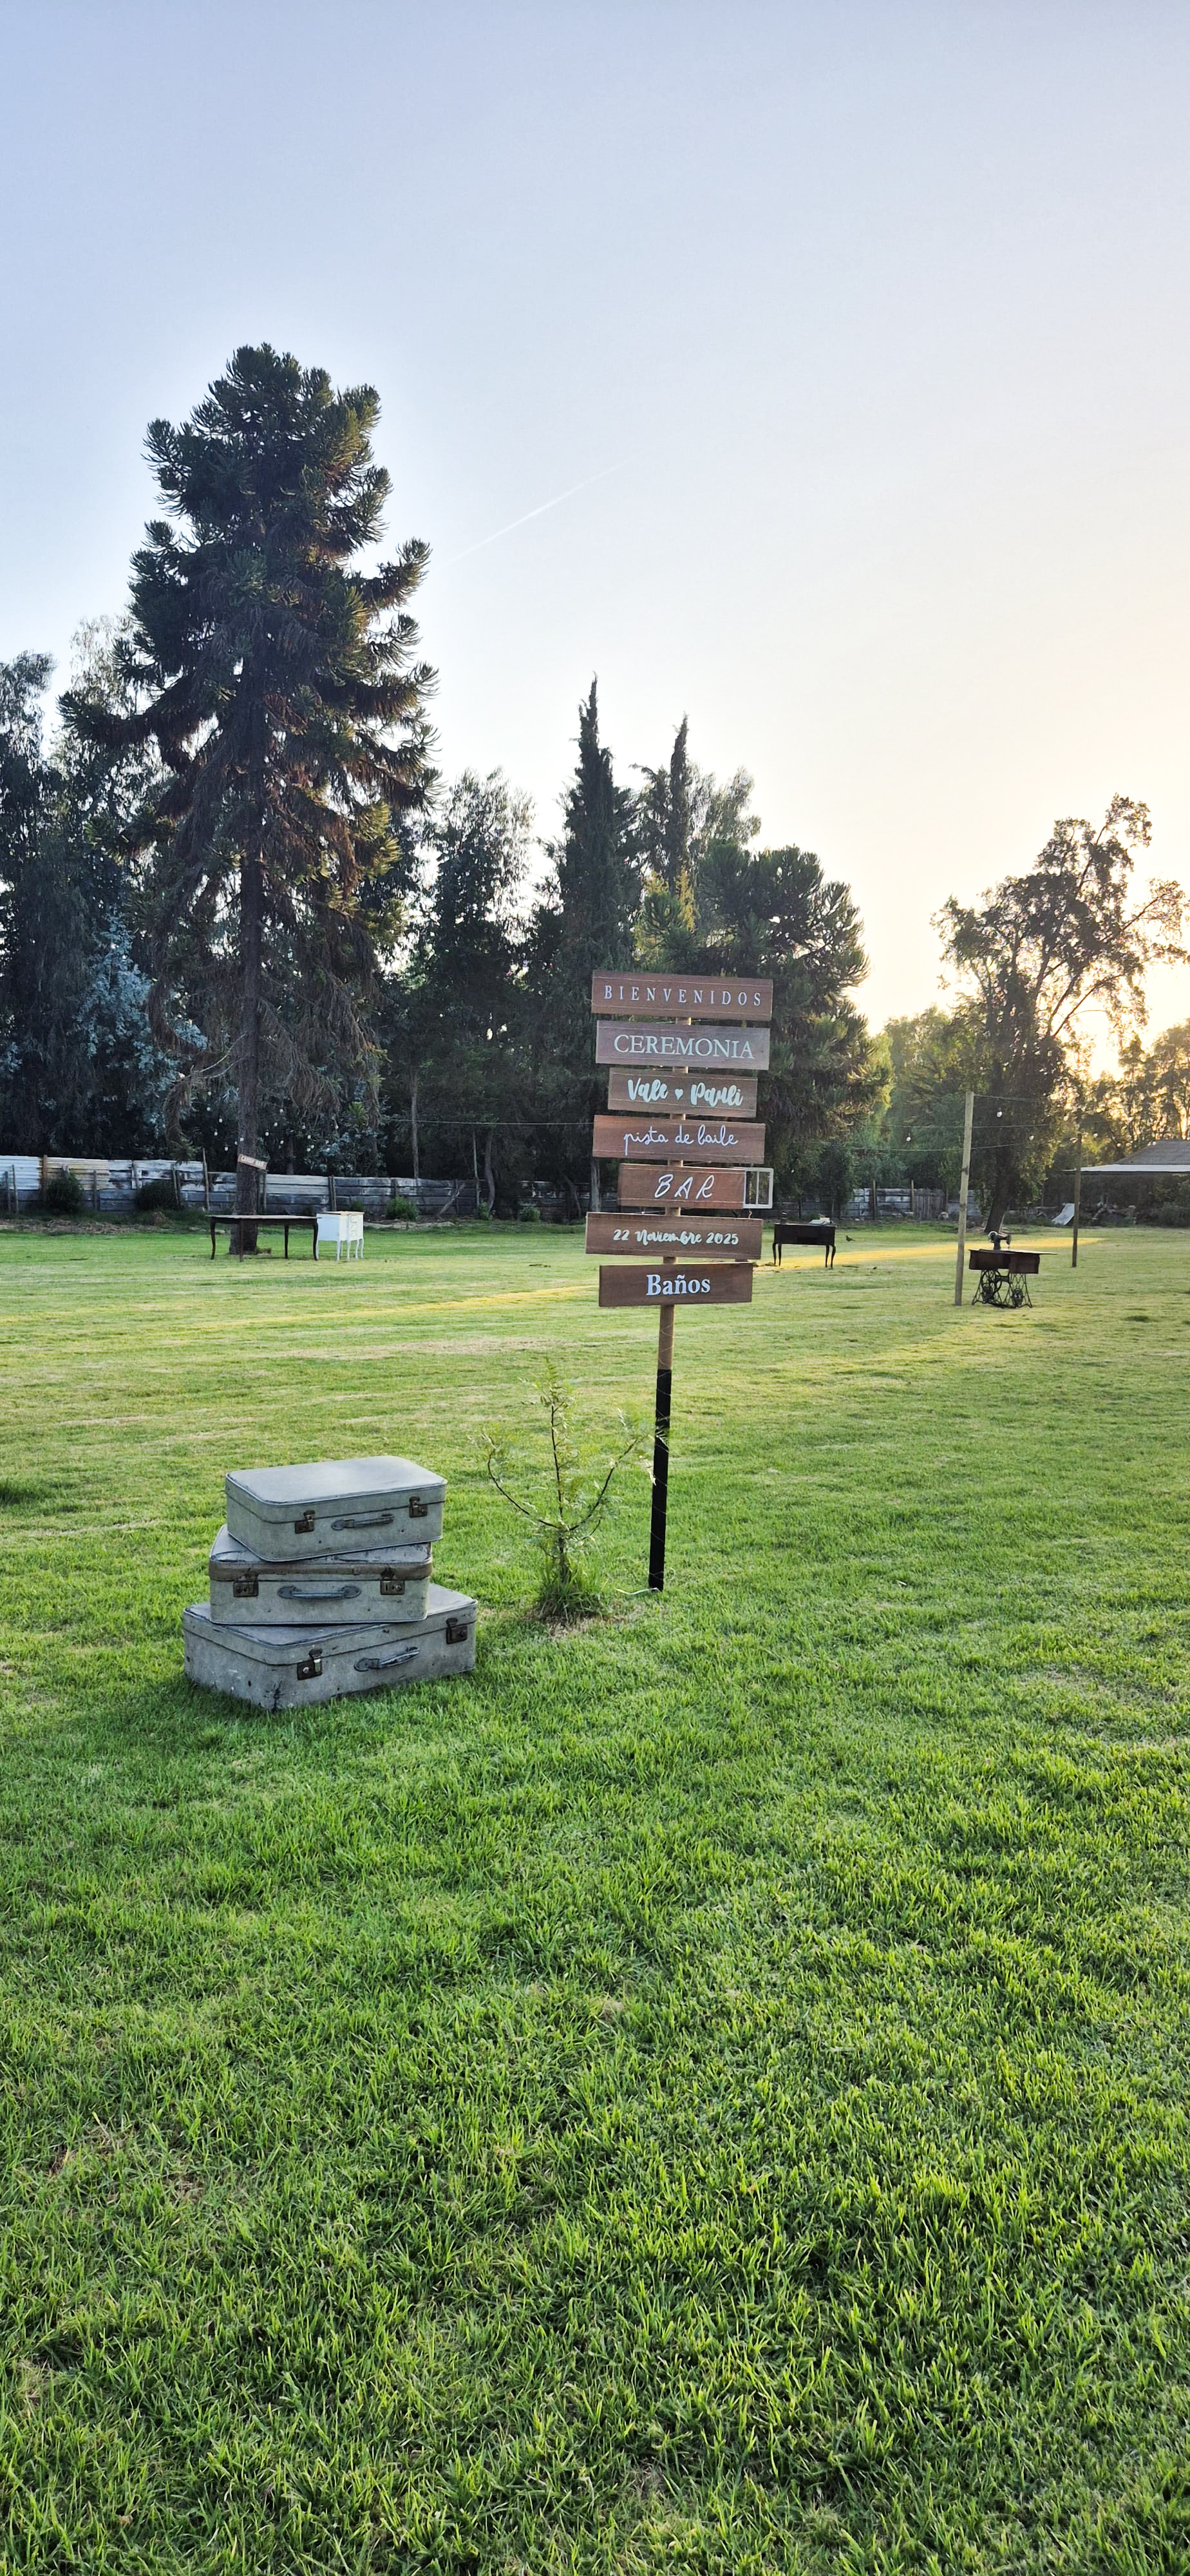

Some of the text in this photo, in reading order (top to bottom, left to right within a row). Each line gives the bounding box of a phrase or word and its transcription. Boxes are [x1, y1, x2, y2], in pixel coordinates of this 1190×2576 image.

[604, 985, 761, 1006] BIENVENIDOS
[614, 1034, 755, 1059] CEREMONIA
[627, 1077, 743, 1107] Vale Pauli
[623, 1124, 739, 1156] pista de baile
[654, 1173, 715, 1199] BAR
[612, 1229, 629, 1241] 22
[705, 1233, 739, 1245] 2025
[646, 1274, 711, 1296] Baños
